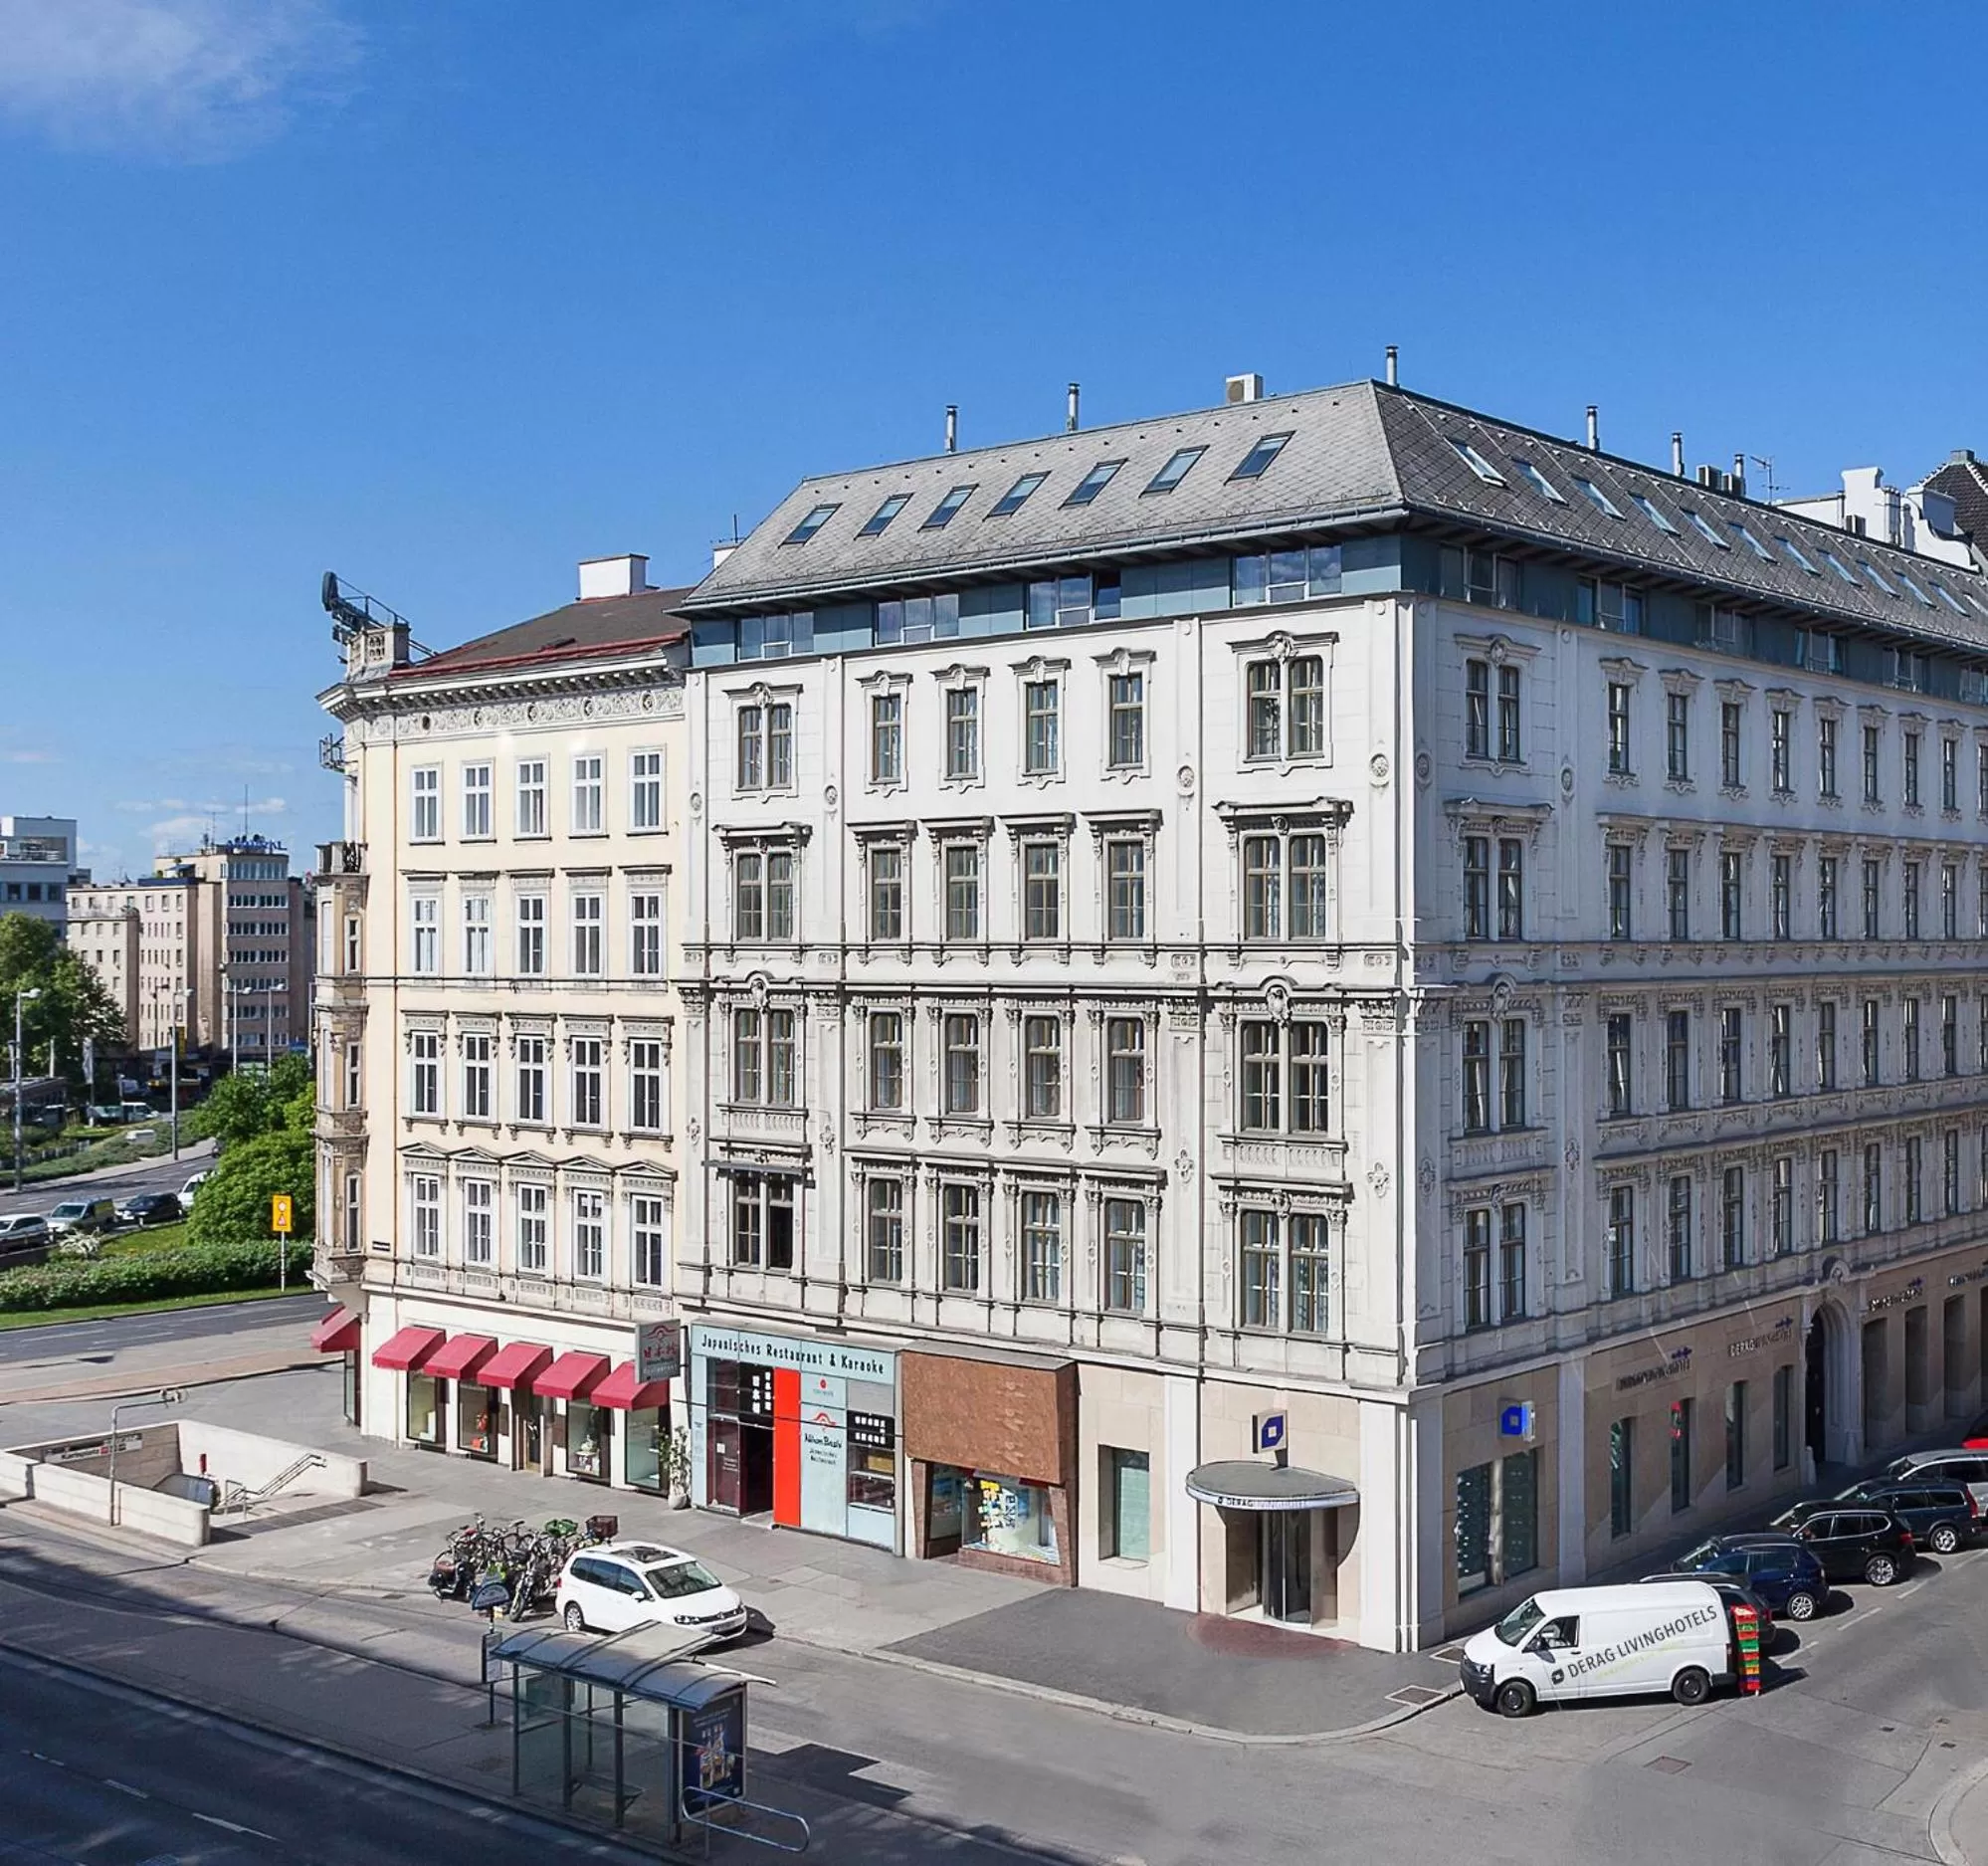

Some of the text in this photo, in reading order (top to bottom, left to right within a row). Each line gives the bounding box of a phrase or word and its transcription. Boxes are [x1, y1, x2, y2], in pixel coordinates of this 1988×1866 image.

[700, 1334, 885, 1374] Japanisches Restaurant & Karaoke
[1567, 1648, 1616, 1678] DERAG
[1616, 1605, 1717, 1658] LIVINGHOTELS
